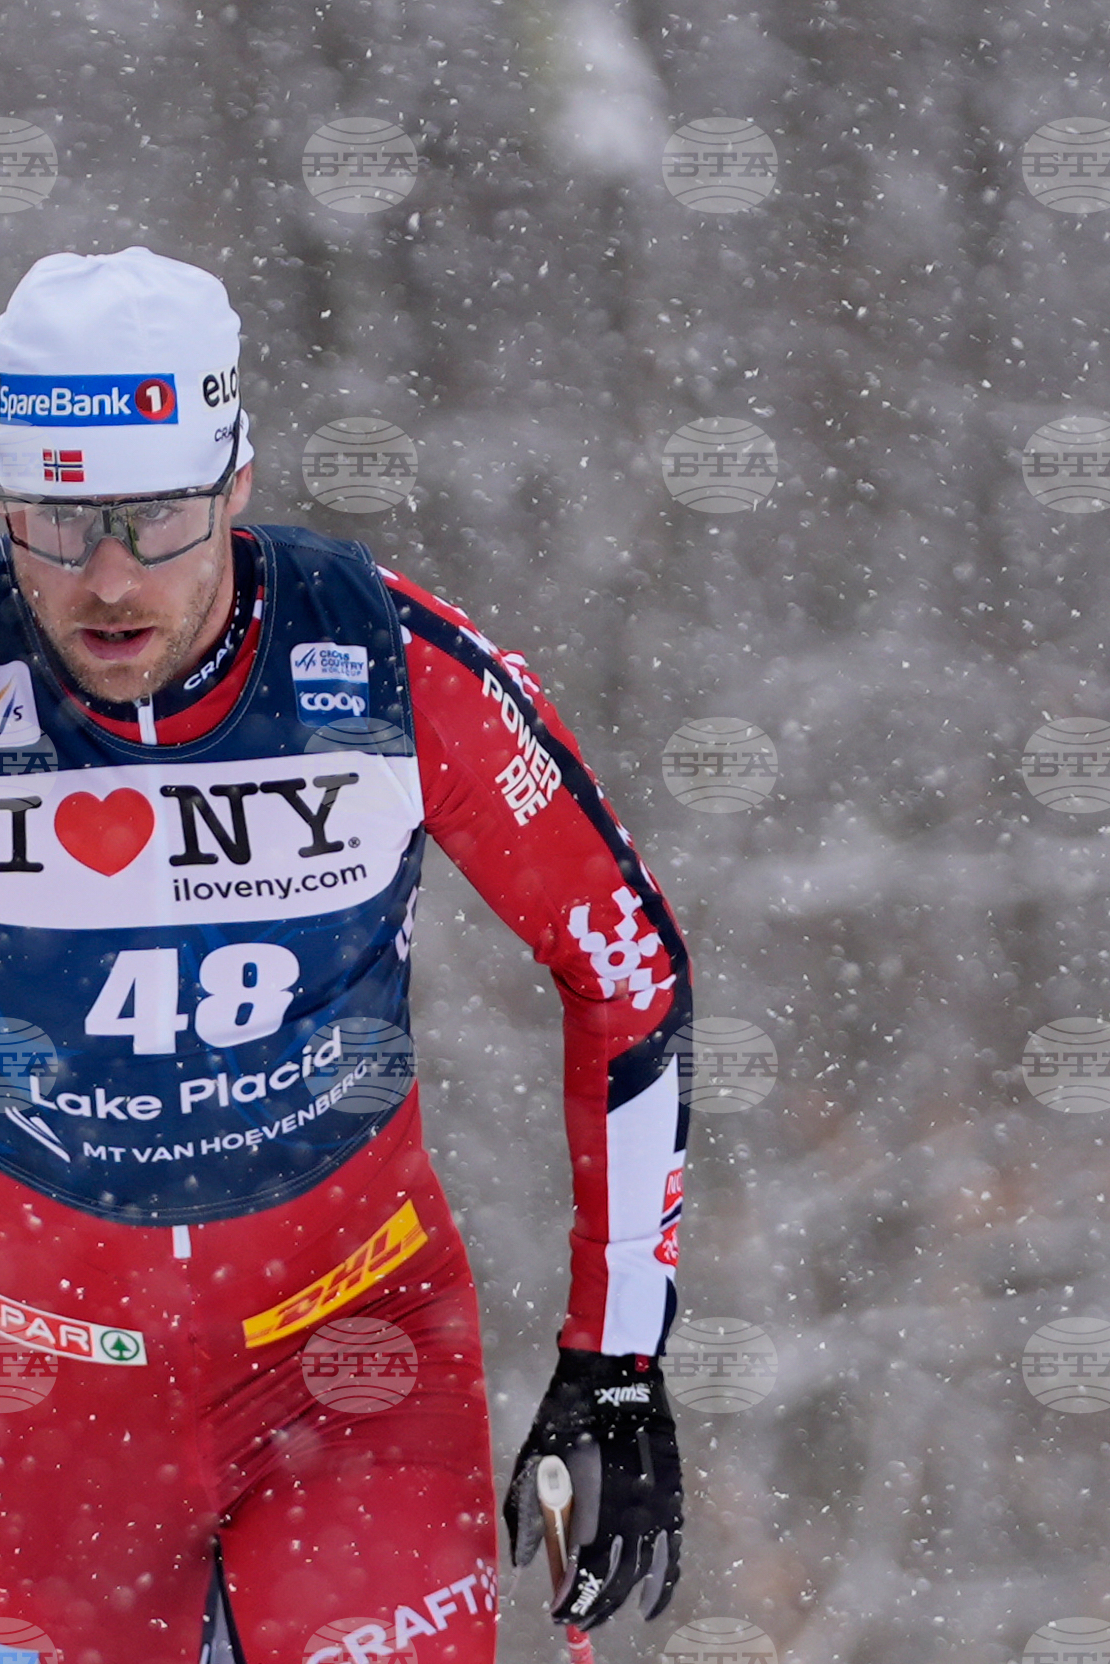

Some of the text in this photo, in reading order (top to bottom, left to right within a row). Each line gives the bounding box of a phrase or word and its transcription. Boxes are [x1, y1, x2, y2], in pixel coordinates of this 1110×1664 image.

[0, 385, 163, 421] SpareBank 1
[299, 691, 366, 717] coop
[482, 668, 563, 801] POWER
[495, 754, 549, 826] ADE
[172, 863, 367, 901] iloveny.com
[84, 943, 300, 1055] 48
[29, 1026, 342, 1121] Lake Placid
[83, 1059, 368, 1164] MT VAN HOEVENBERG
